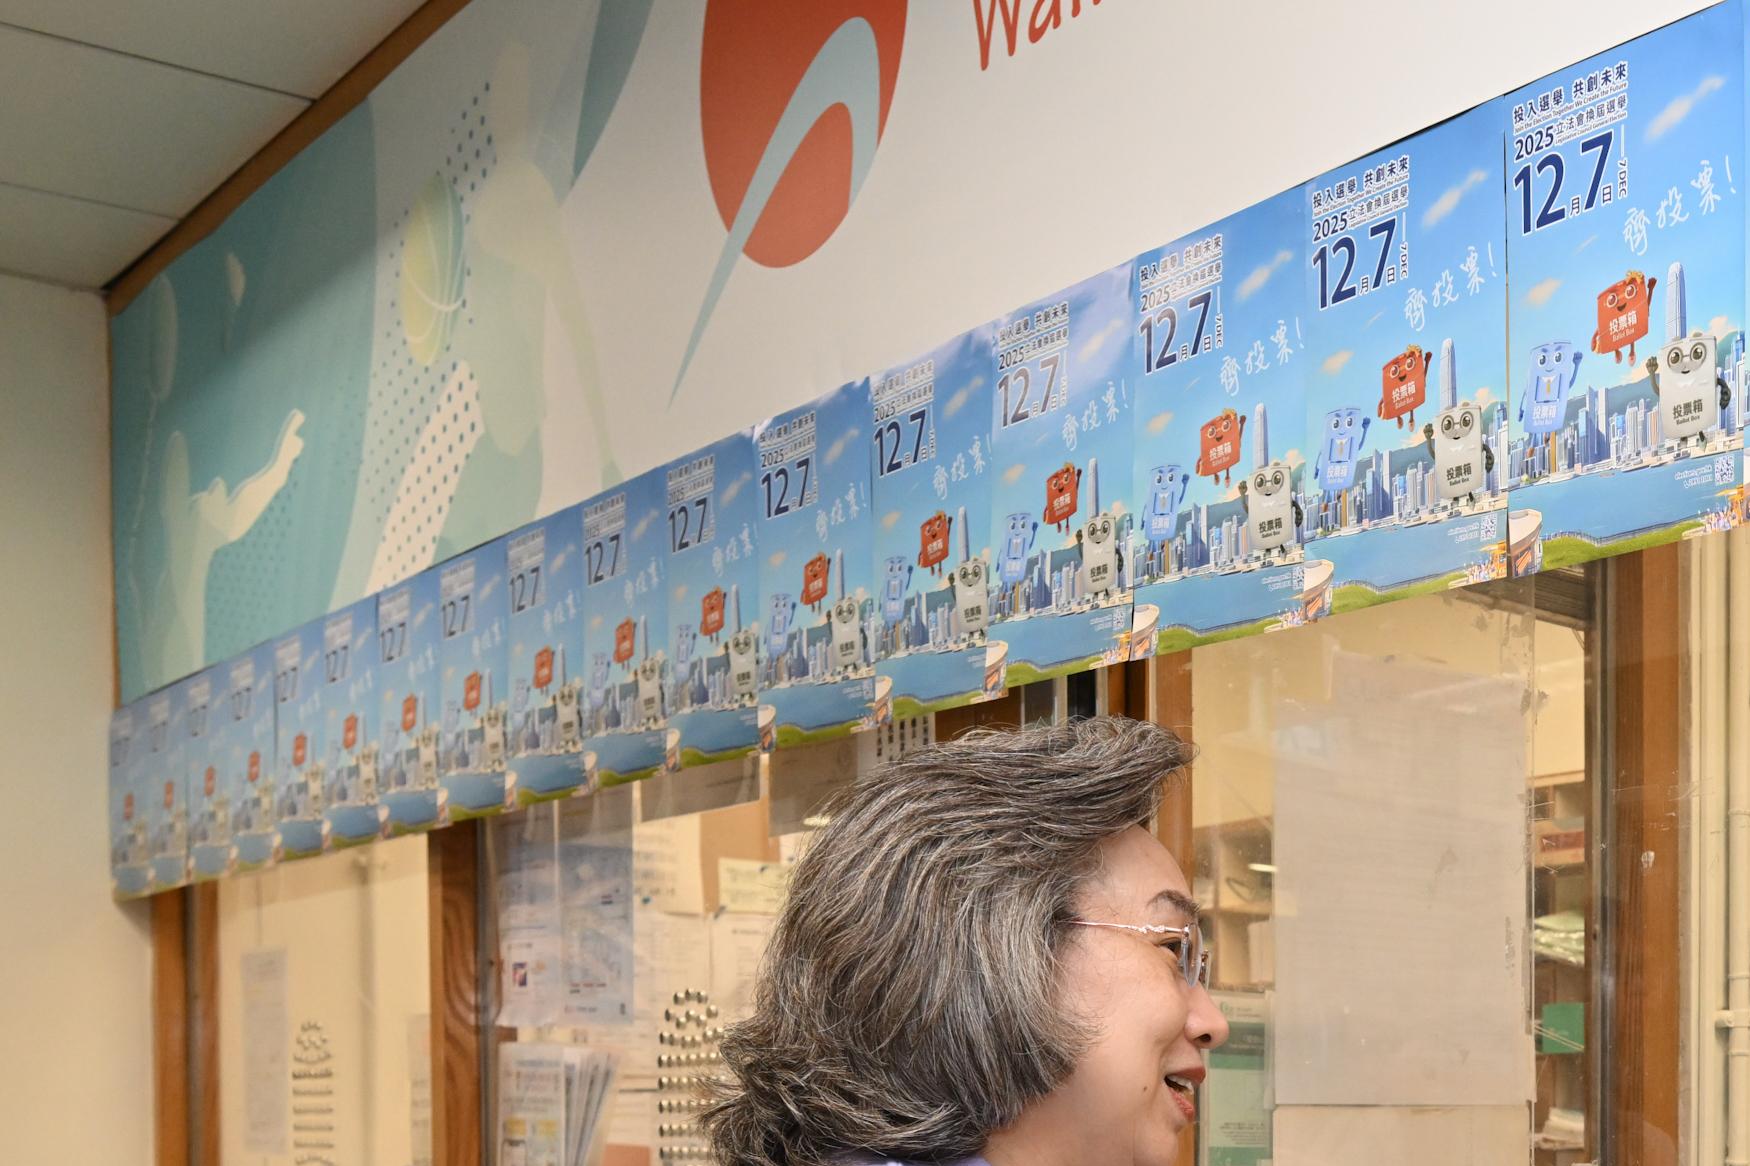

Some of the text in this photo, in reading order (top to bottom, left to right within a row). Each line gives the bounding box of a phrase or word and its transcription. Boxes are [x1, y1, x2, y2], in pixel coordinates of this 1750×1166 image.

[1514, 64, 1626, 124] 投入選舉 共創未來
[1576, 100, 1583, 108] We
[1584, 93, 1599, 105] Create
[1610, 83, 1626, 94] Future
[1619, 160, 1626, 168] 7
[1314, 158, 1408, 208] 投入選舉 共創未來
[1609, 311, 1637, 334] 投票箱
[1393, 381, 1415, 402] 投票箱
[1673, 399, 1703, 418] 投票箱
[1446, 463, 1471, 479] 投票箱
[1259, 518, 1282, 532] 投票箱
